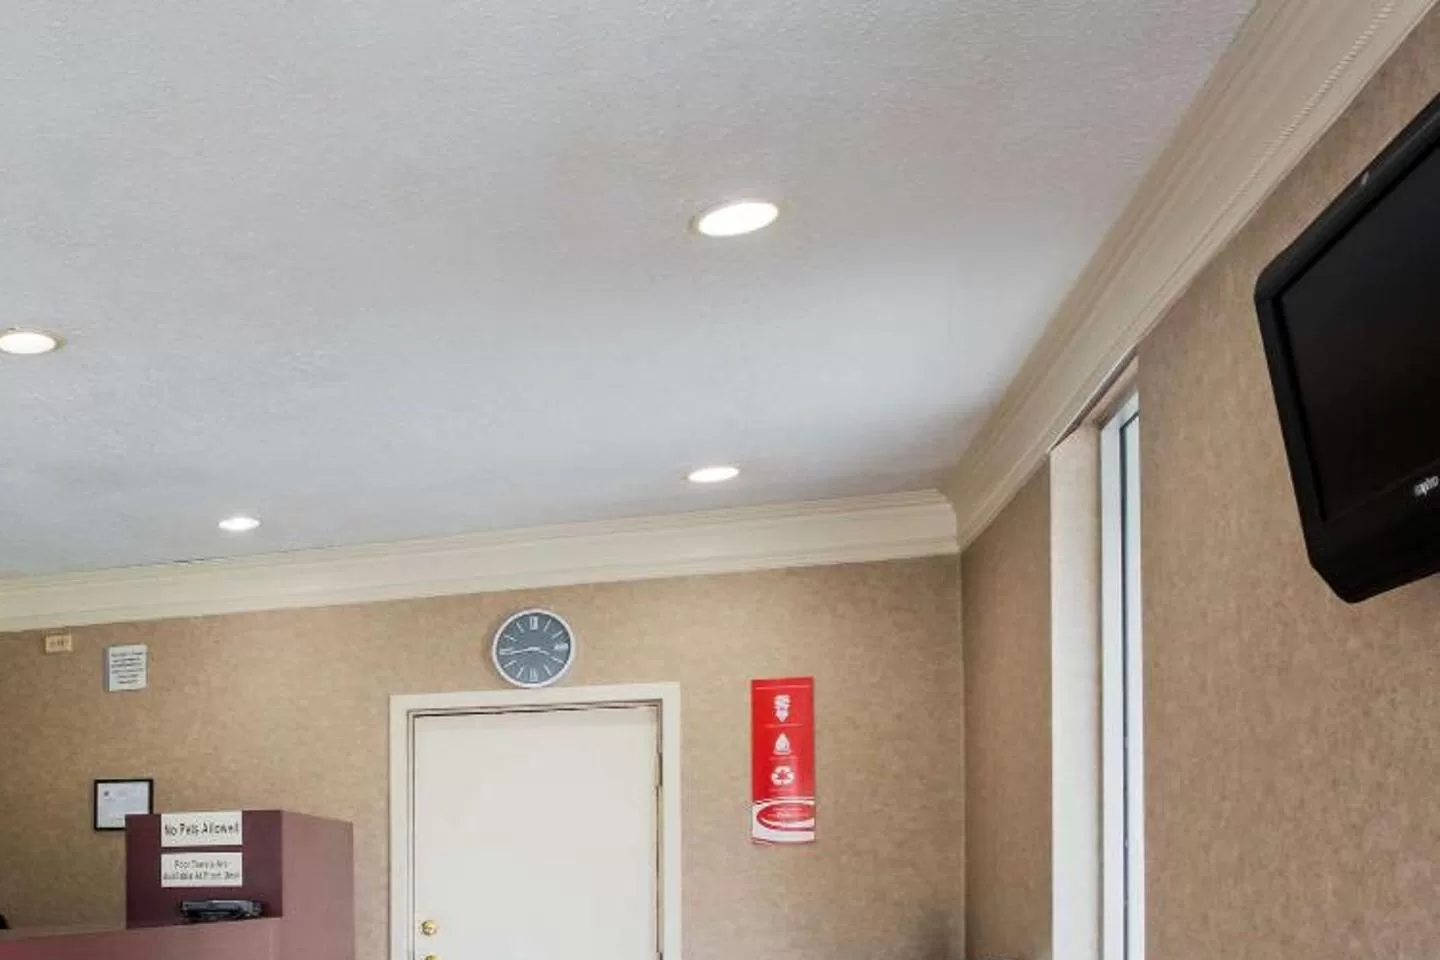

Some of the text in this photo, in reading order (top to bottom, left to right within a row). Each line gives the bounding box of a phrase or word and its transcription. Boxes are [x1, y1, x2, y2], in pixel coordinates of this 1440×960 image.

[164, 820, 240, 836] No Pets Allowed
